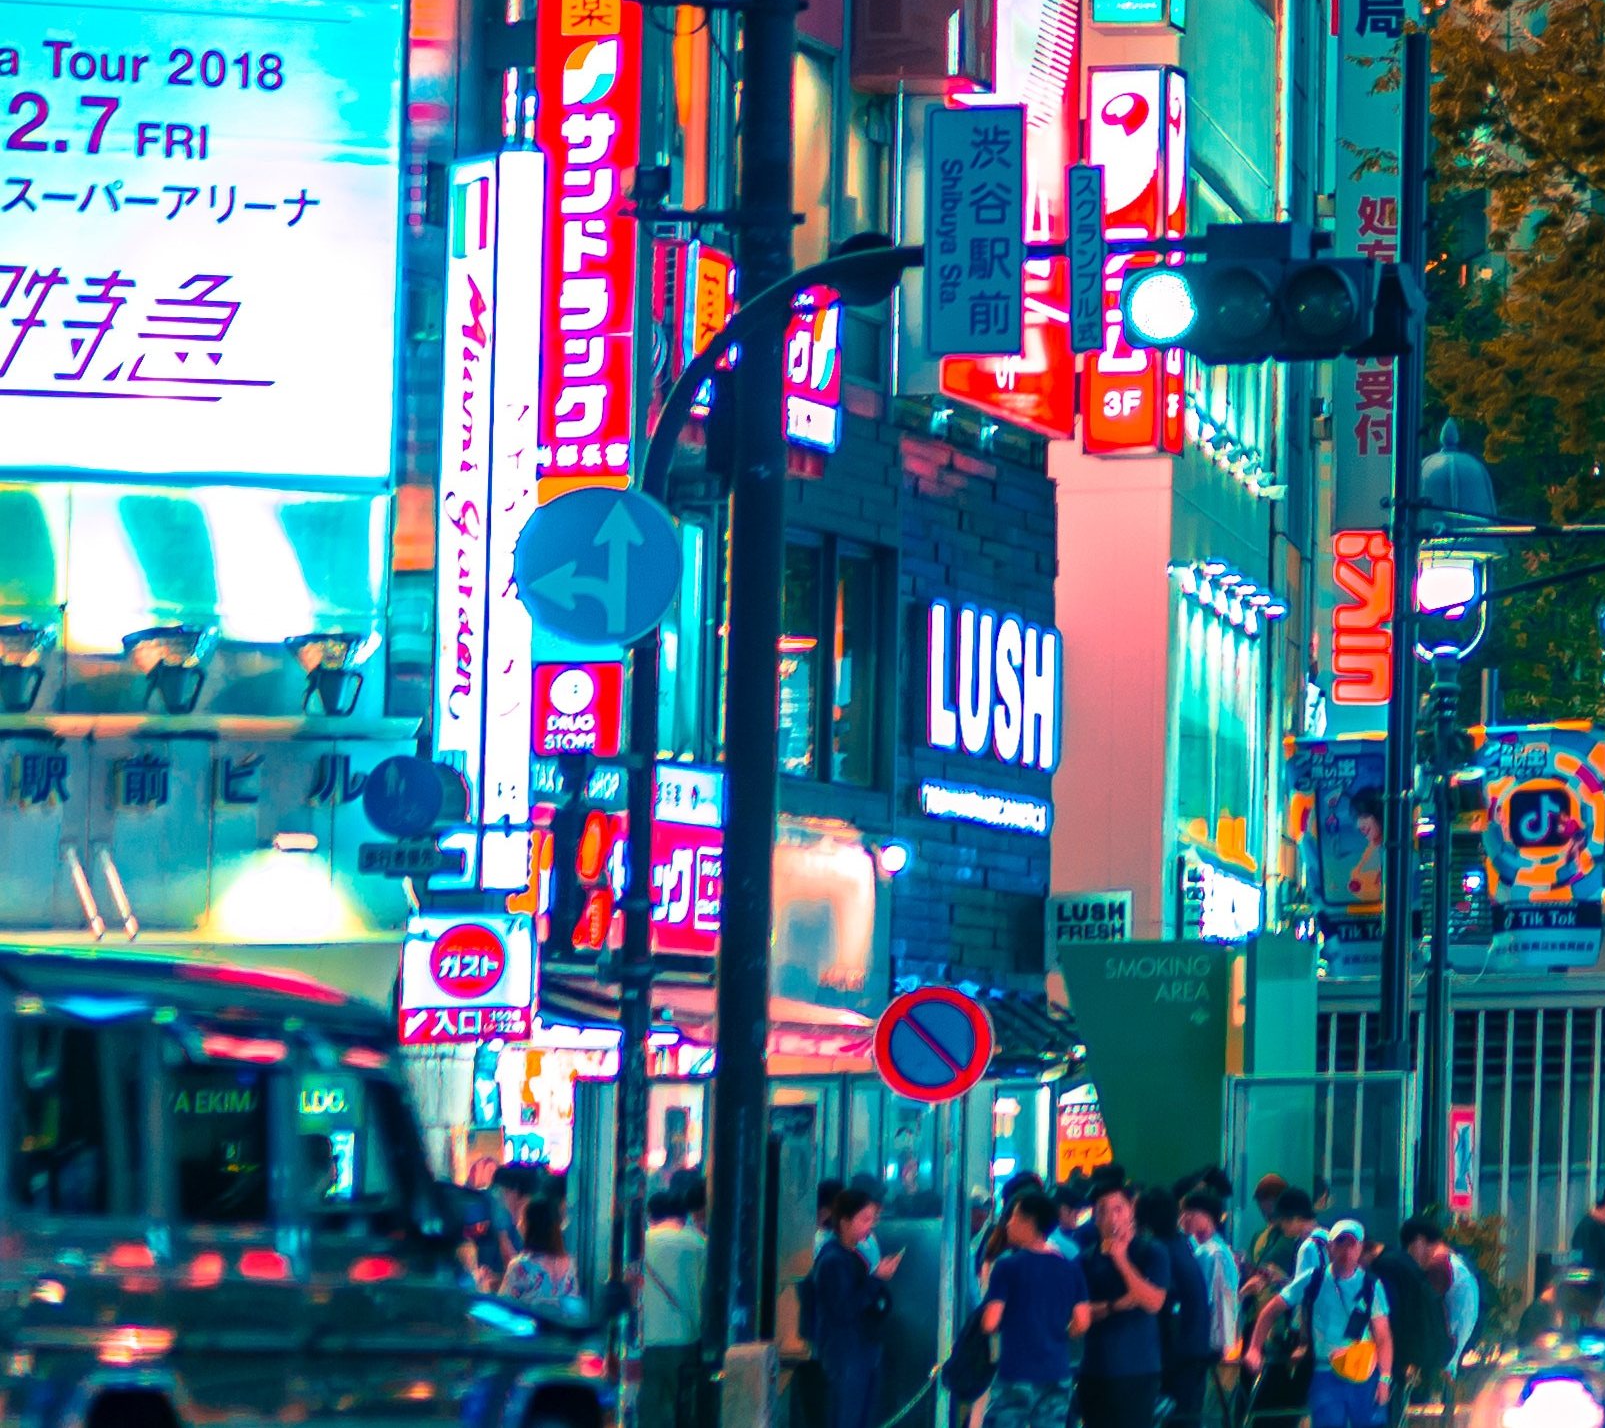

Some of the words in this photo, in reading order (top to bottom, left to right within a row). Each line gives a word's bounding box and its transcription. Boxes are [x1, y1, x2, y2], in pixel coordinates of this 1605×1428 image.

[44, 41, 149, 85] Tour
[169, 48, 284, 91] 2018
[137, 124, 209, 160] FRI
[2, 176, 321, 228] スーパーアリーナ
[937, 157, 965, 254] Shibuya
[967, 125, 1014, 338] 渋谷駅前
[554, 111, 616, 440] サンドラッグ
[1075, 174, 1099, 345] スクランブル式
[938, 262, 963, 313] Sta.
[1102, 388, 1143, 418] 3F
[927, 602, 1058, 774] LUSH
[21, 752, 367, 809] 駅前ビル
[1055, 902, 1126, 923] LUSH
[1518, 912, 1543, 927] Tik
[1549, 911, 1577, 927] Tok
[436, 955, 499, 981] ガスト
[1105, 956, 1212, 980] SMOKING
[1155, 980, 1211, 1003] AREA
[429, 1010, 482, 1038] 入口
